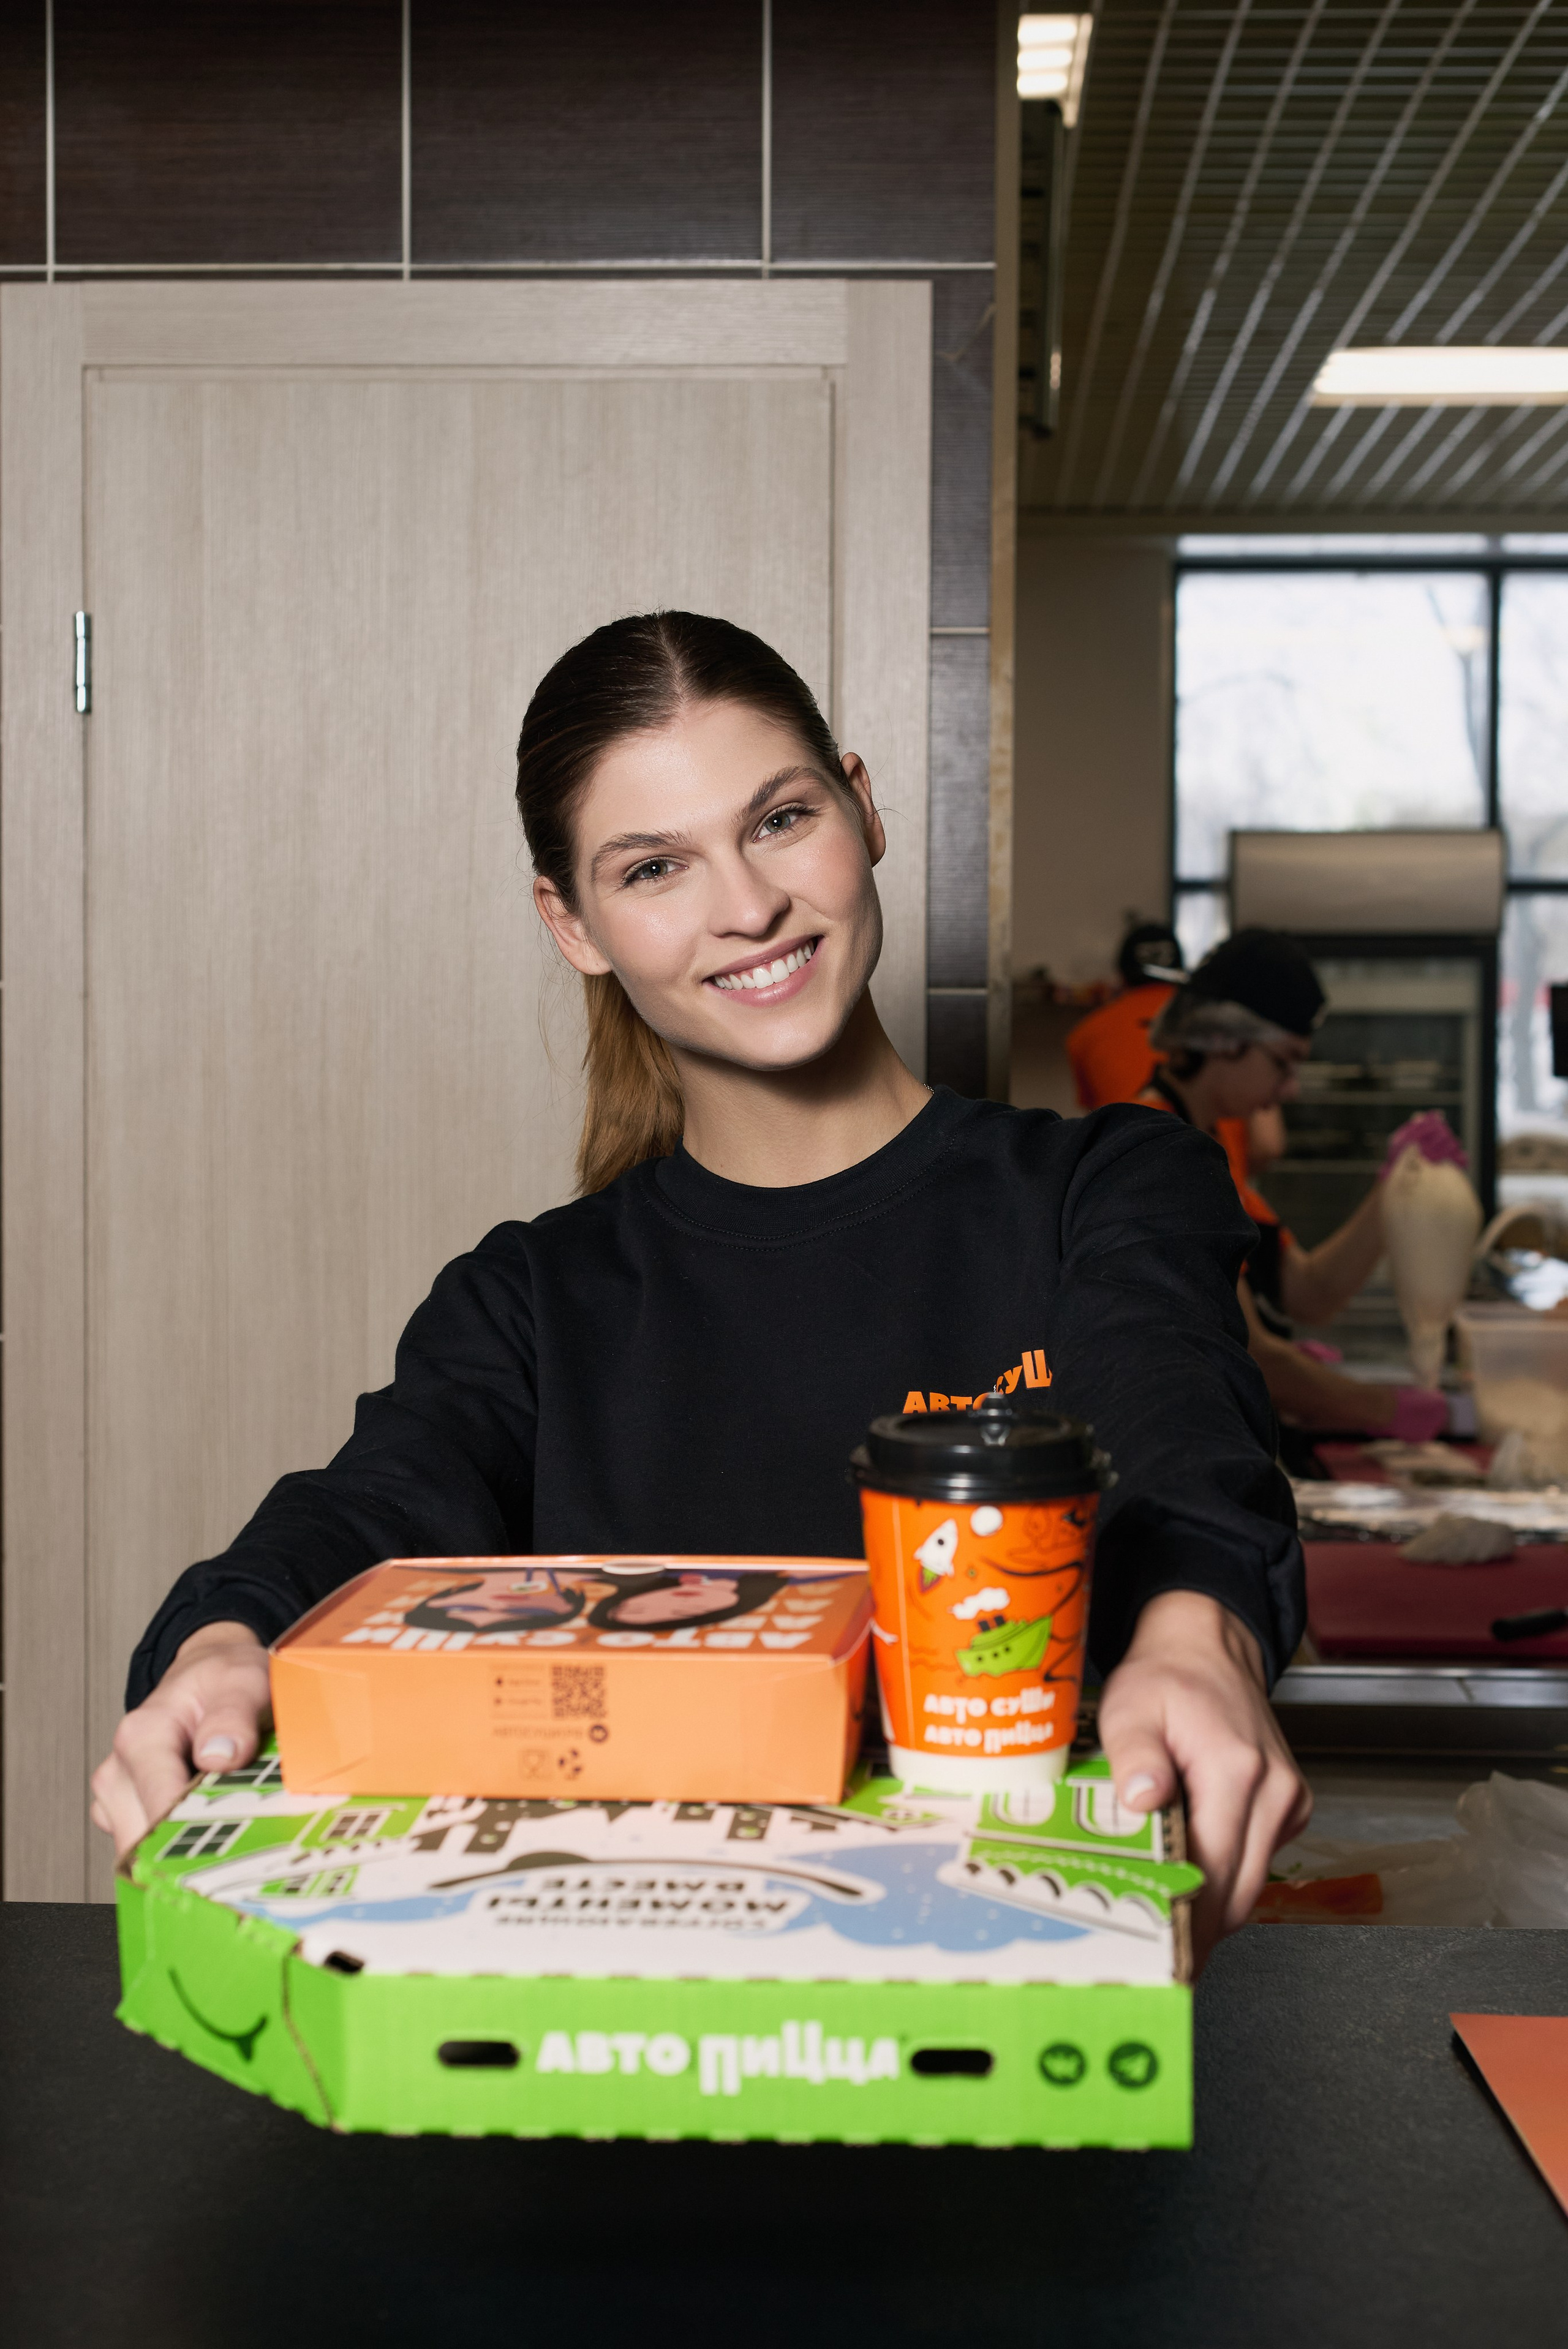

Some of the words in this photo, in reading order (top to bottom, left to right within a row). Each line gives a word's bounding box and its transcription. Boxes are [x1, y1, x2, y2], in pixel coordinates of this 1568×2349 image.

[996, 1349, 1053, 1395] СУШ
[595, 1626, 815, 1650] АВТО
[924, 1693, 987, 1725] АВТО
[924, 1724, 983, 1748] АВТО
[488, 1896, 787, 1913] МОМЕНТЫ
[535, 2030, 692, 2077] АВТО
